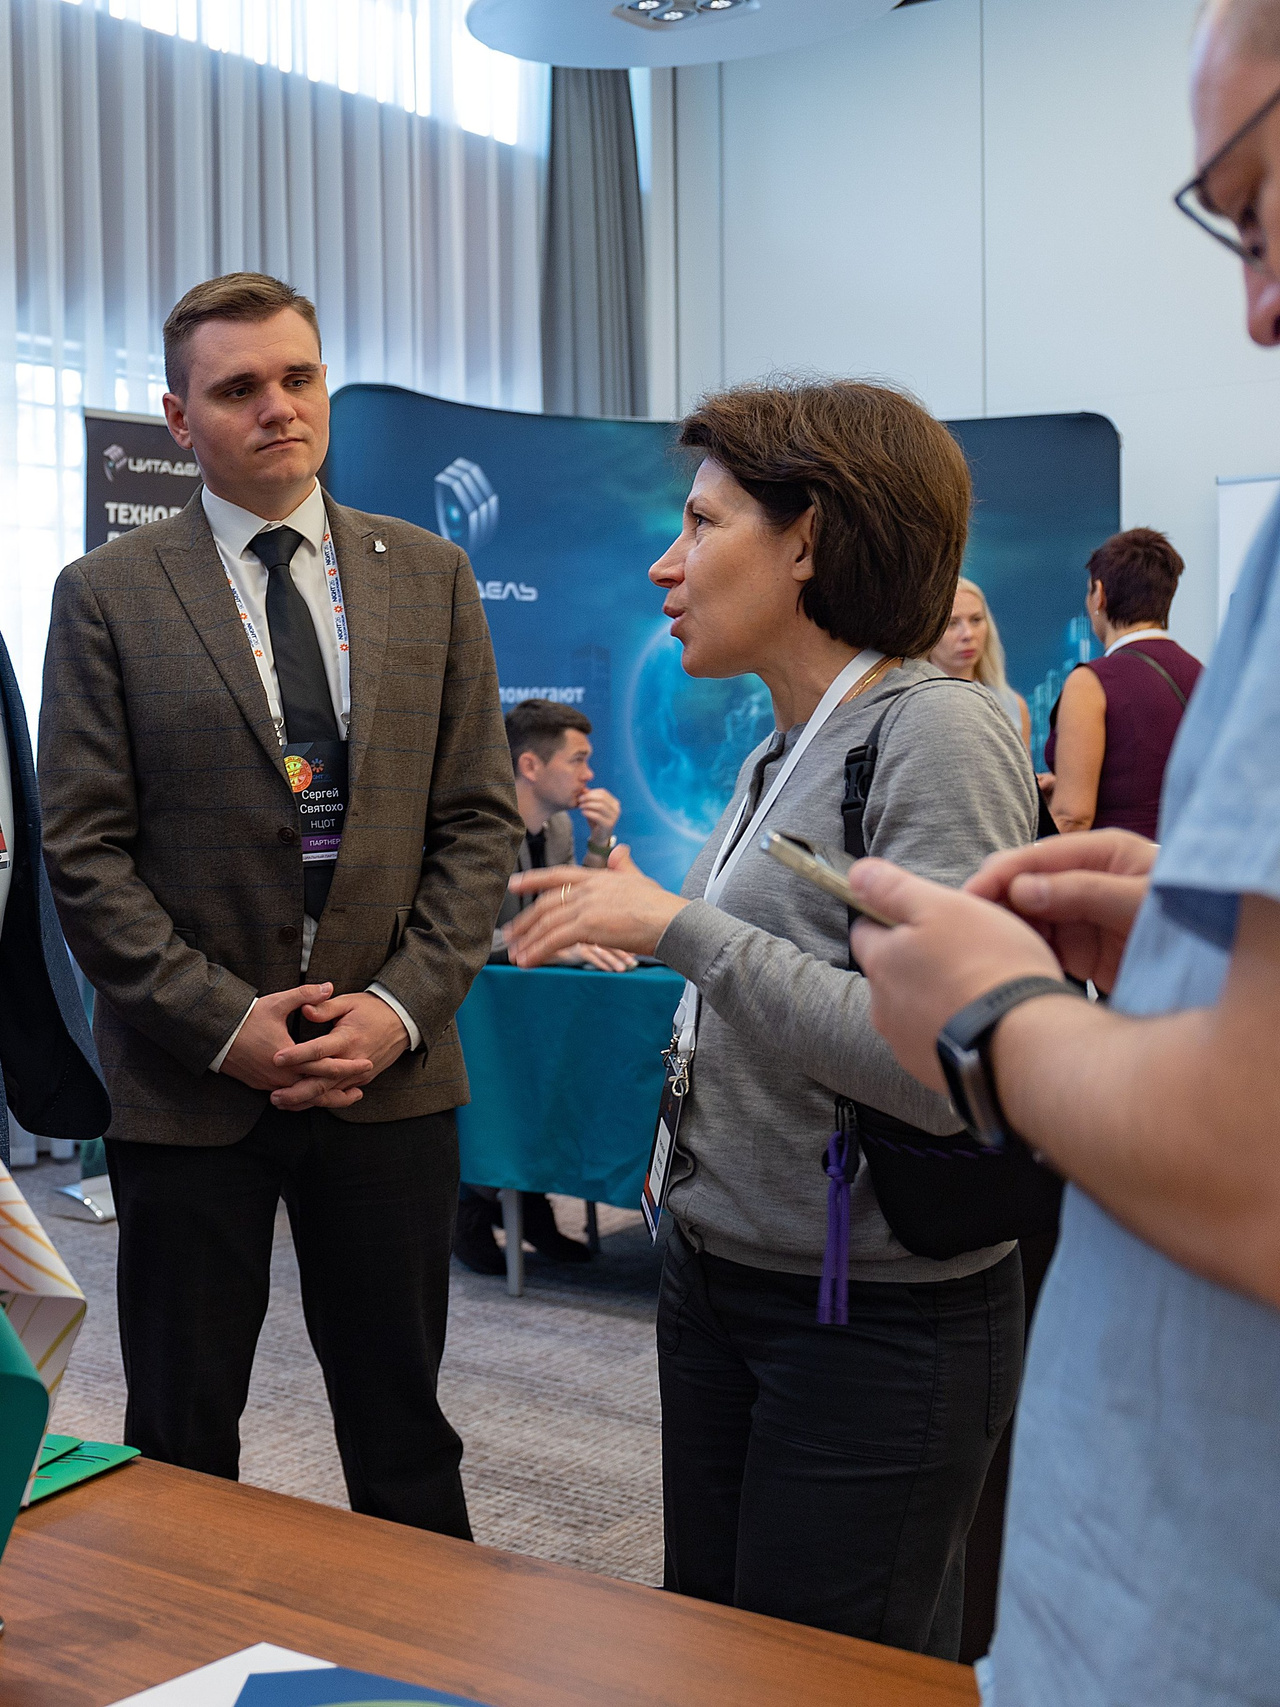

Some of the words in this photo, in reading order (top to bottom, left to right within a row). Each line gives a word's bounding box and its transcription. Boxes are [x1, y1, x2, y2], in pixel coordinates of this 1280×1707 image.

[128, 458, 201, 477] ЦИТАДЕ
[301, 787, 339, 800] Сергей
[299, 803, 344, 814] Святохо
[310, 819, 336, 829] НЦОТ
[309, 838, 341, 847] ПАРТНЕР
